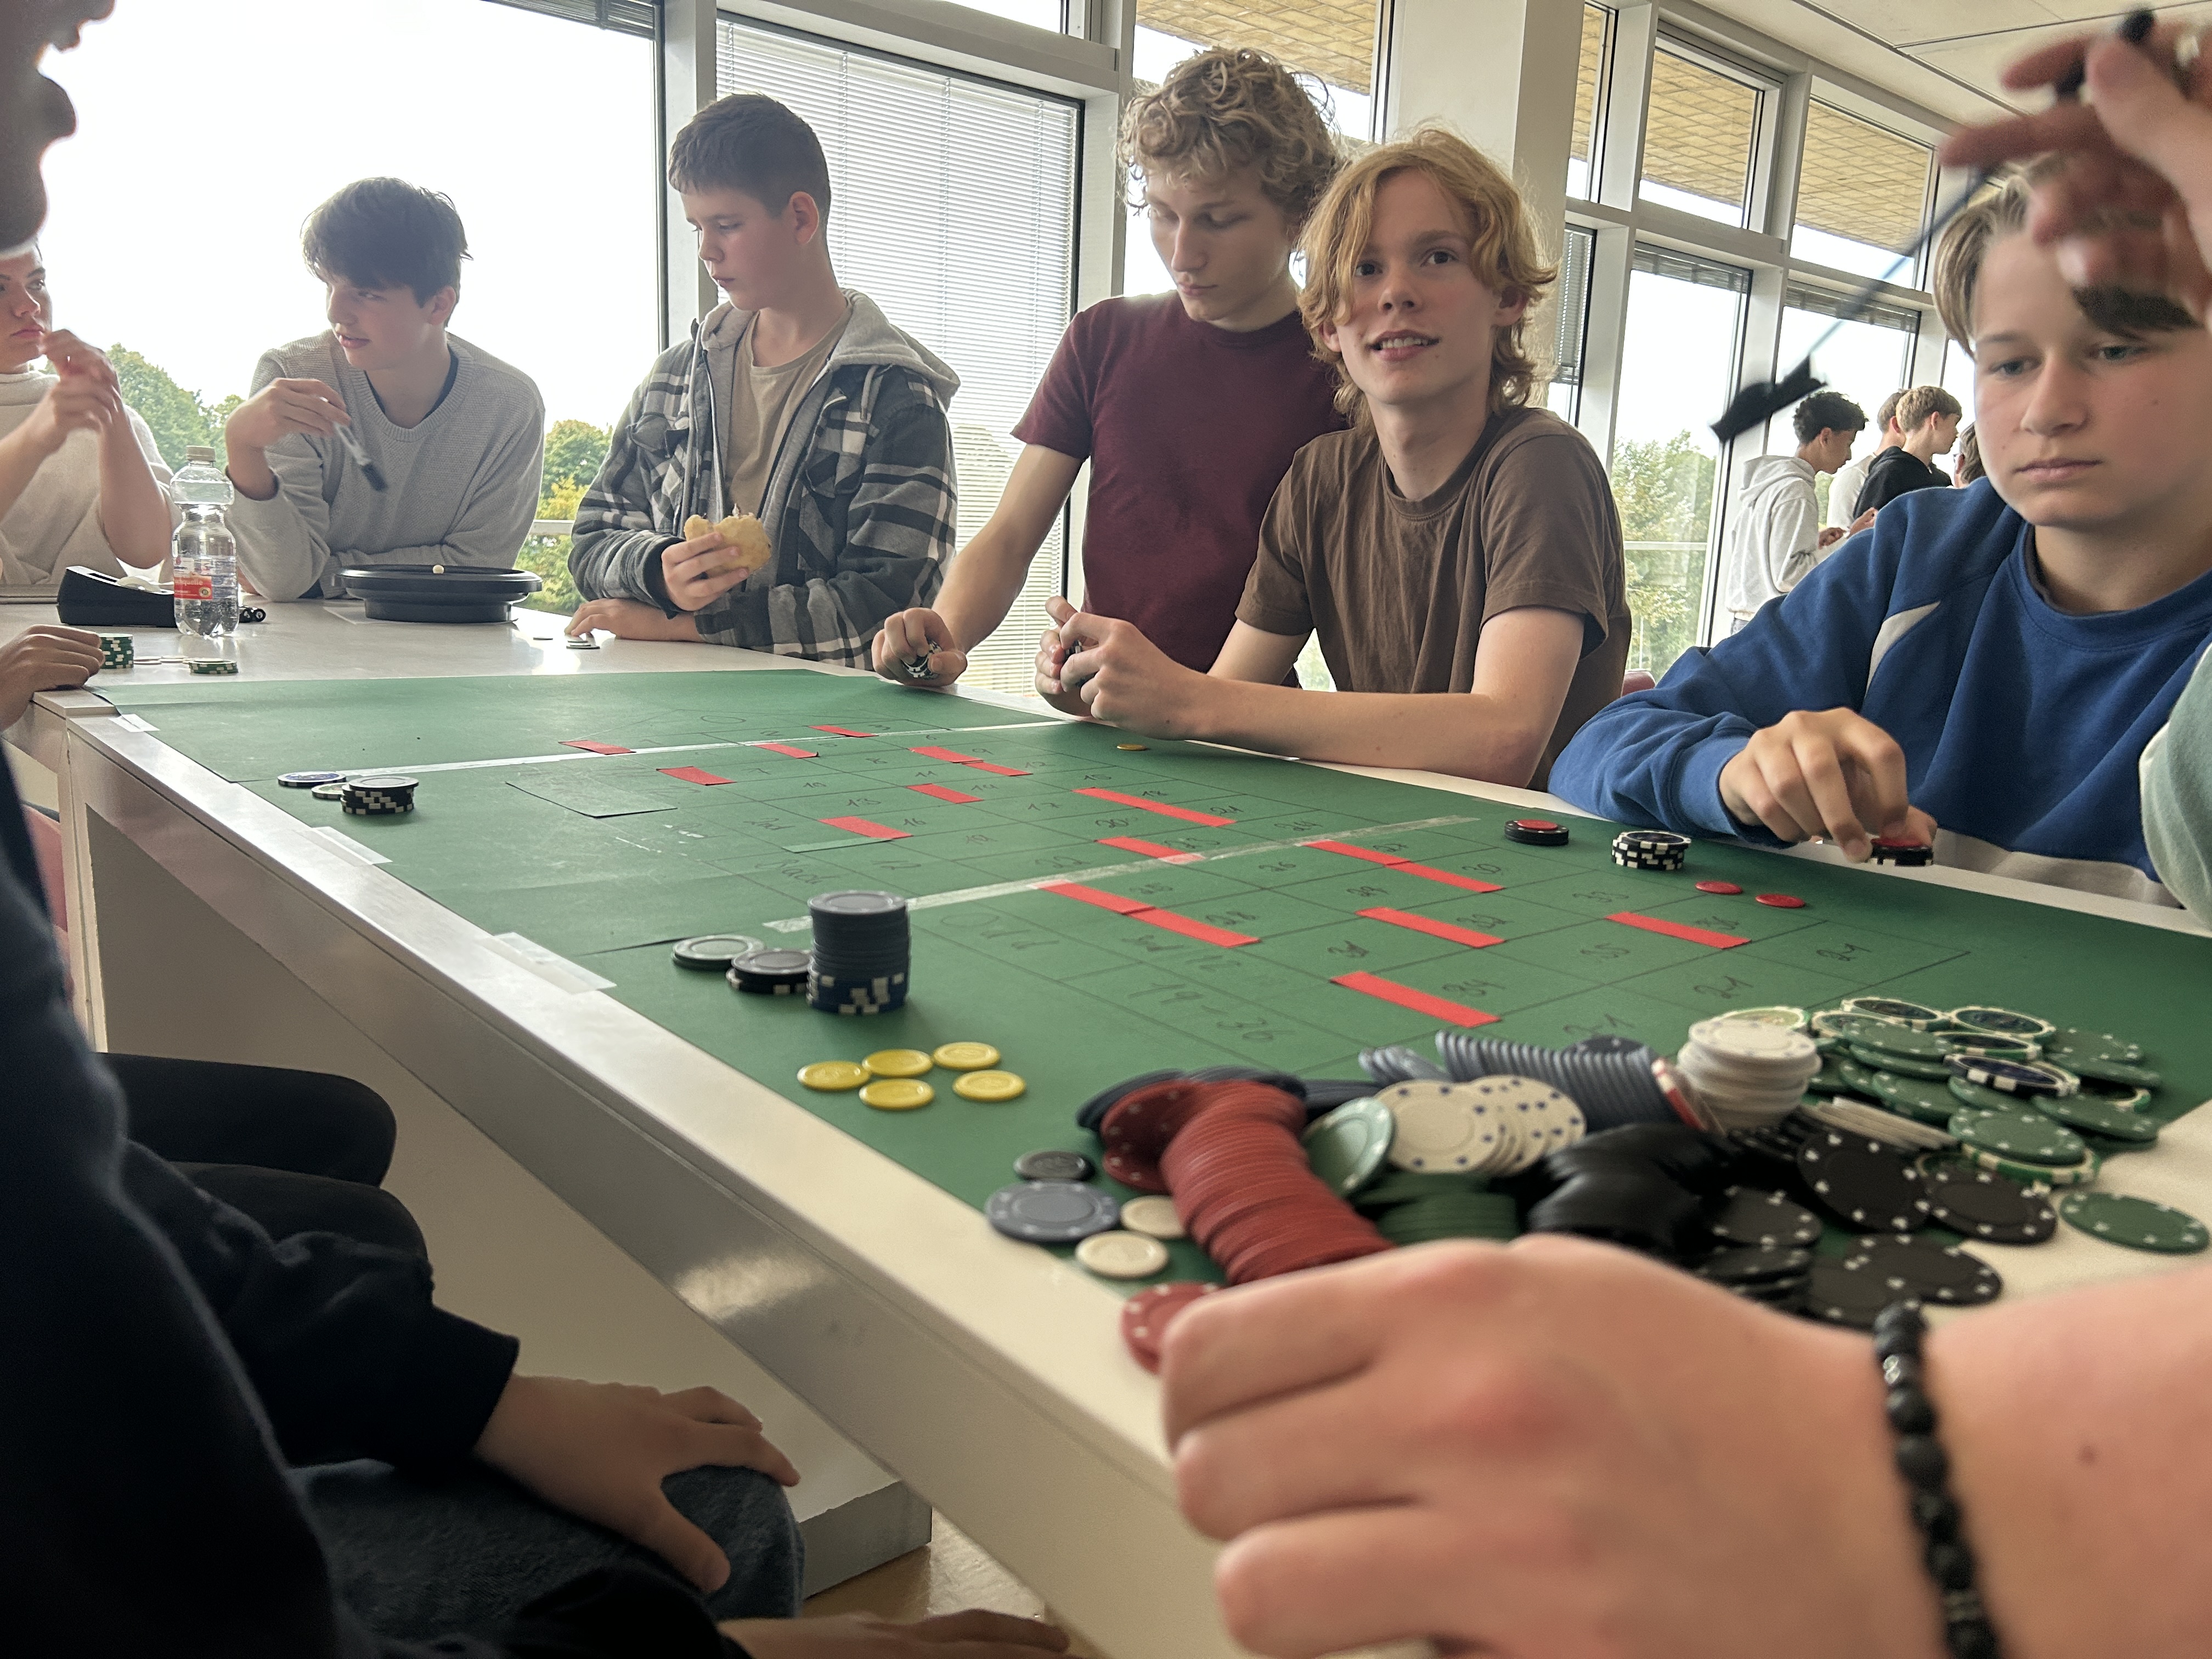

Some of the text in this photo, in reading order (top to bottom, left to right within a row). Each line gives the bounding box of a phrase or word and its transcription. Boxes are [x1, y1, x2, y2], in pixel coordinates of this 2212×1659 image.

[699, 715, 747, 724] 0
[846, 798, 882, 807] 13
[1028, 803, 1063, 811] 17
[1209, 805, 1244, 814] 21
[904, 818, 928, 826] 16
[1094, 818, 1130, 828] 20
[1373, 843, 1408, 852] 27
[1034, 856, 1093, 869] 22
[1257, 861, 1297, 872] 26
[1462, 864, 1503, 874] 30
[1572, 891, 1630, 902] 33
[1456, 914, 1513, 929] 32
[1127, 982, 1297, 1043] 19-36
